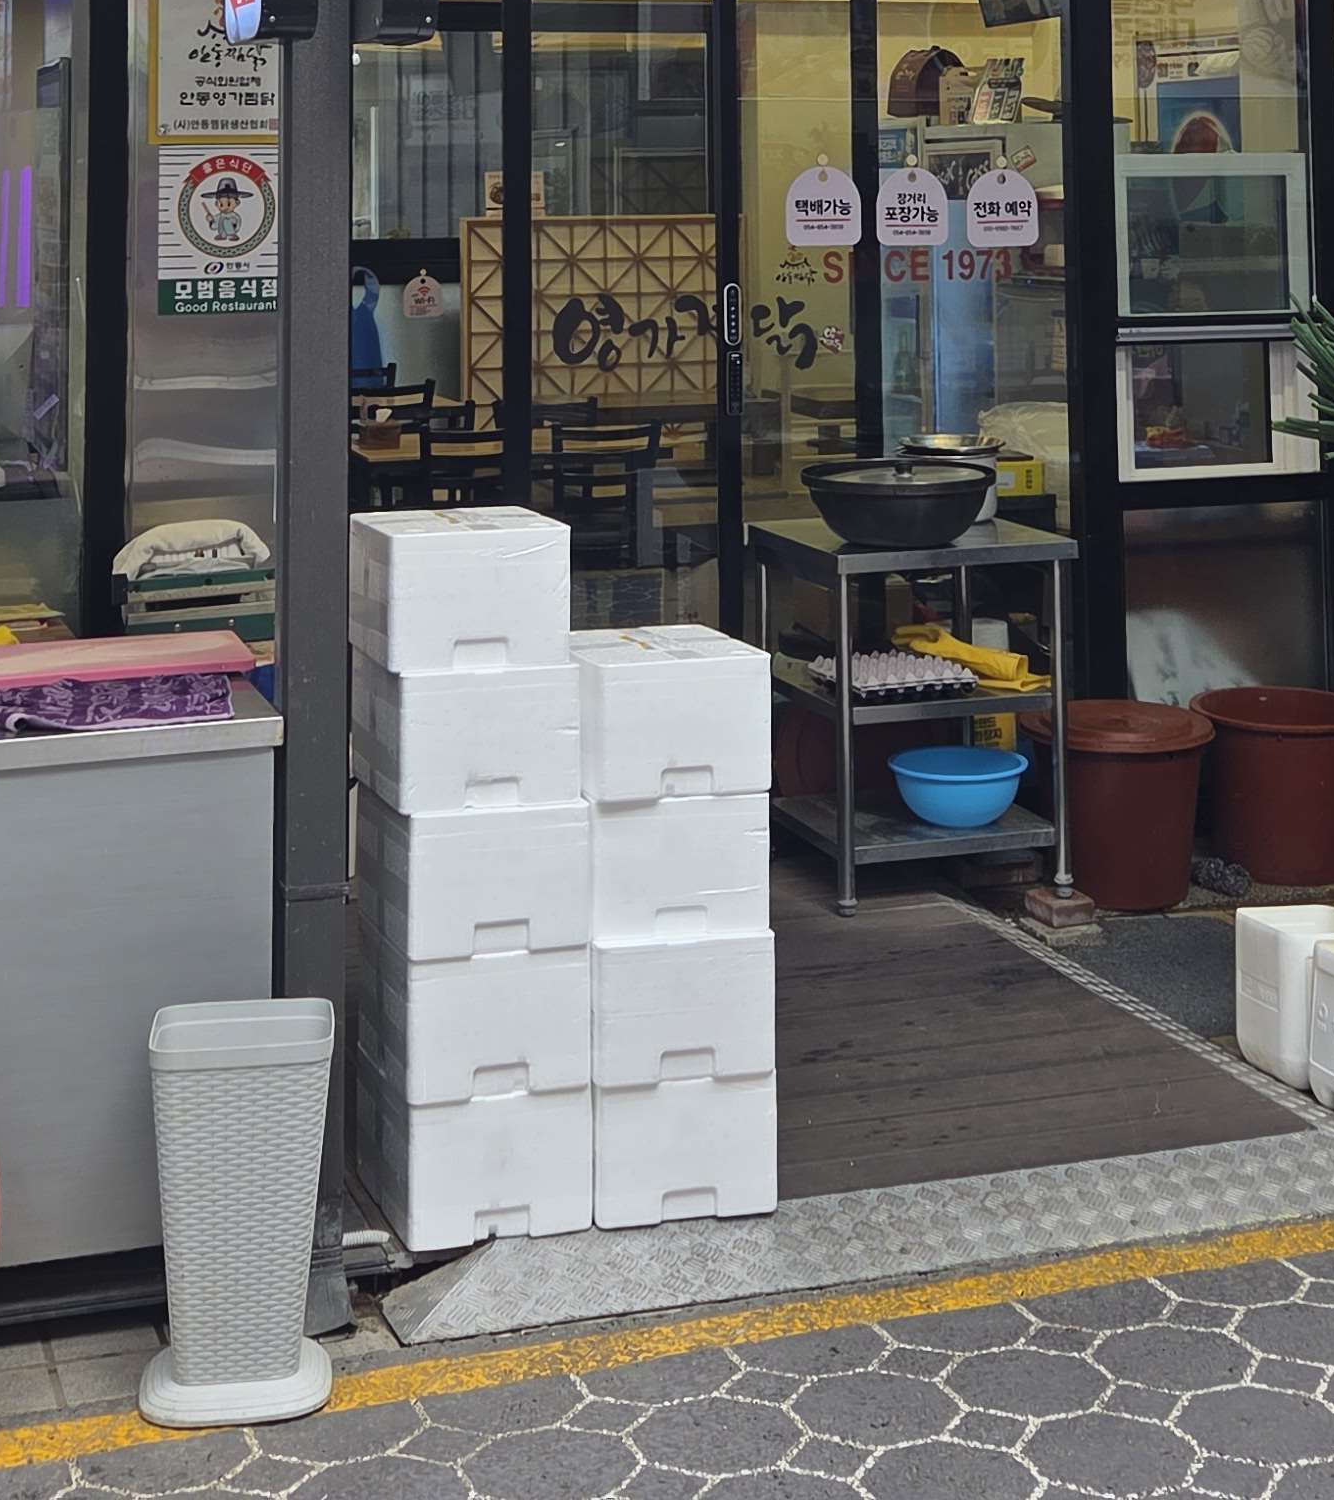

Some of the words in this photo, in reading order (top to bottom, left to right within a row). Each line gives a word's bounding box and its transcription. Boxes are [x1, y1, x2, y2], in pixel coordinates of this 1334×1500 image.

[179, 91, 276, 107] 안동영가찜닭
[794, 198, 853, 216] 택배가능
[897, 192, 926, 205] 장거리
[884, 205, 940, 223] 포장가능
[973, 201, 1001, 218] 전화
[1004, 200, 1033, 217] 예약
[822, 249, 931, 284] SCE
[942, 249, 1013, 282] 1973
[174, 279, 278, 300] 모범음식점
[175, 301, 208, 314] Good
[212, 299, 277, 312] Restaurant
